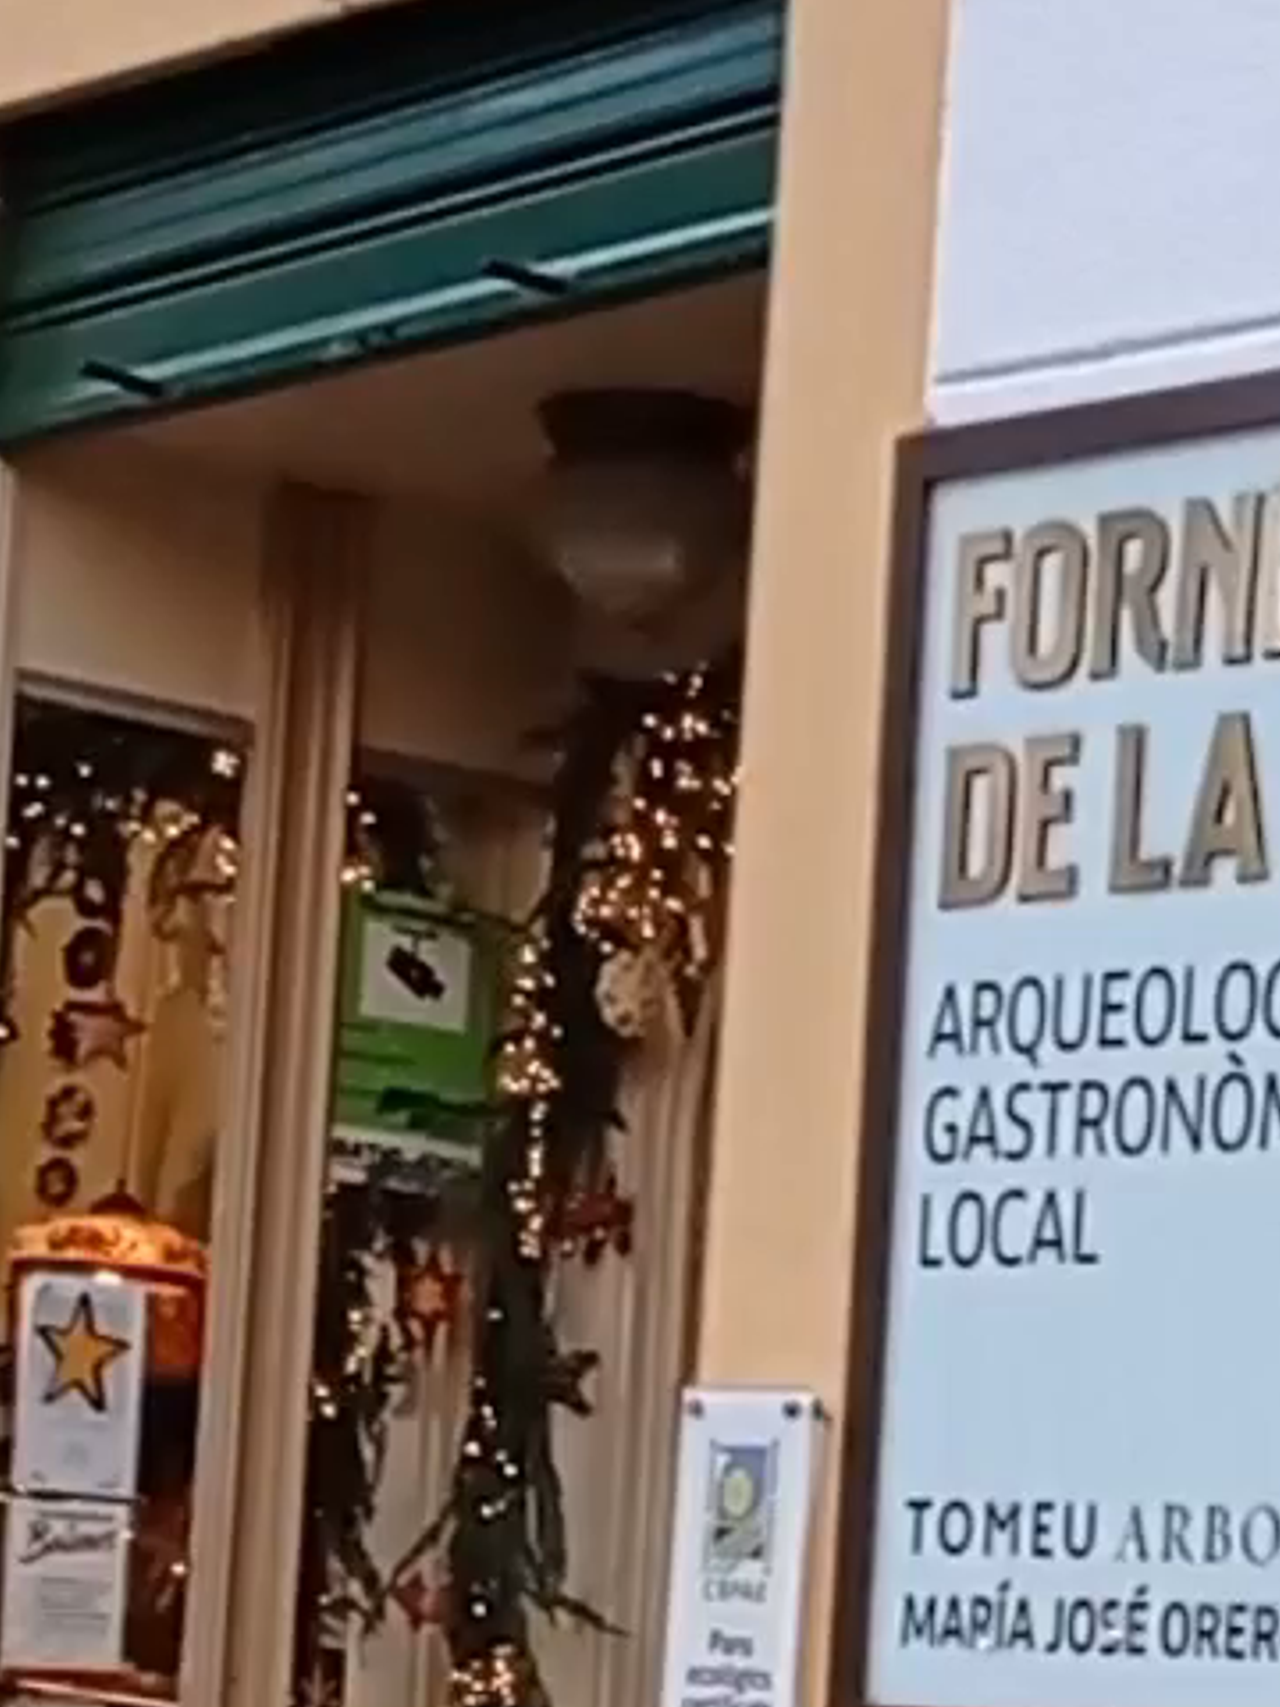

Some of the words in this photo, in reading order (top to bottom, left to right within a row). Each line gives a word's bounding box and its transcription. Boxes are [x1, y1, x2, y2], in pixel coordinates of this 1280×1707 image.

[937, 730, 1082, 911] DE
[1107, 711, 1272, 895] LA
[917, 1187, 1100, 1269] LOCAL
[906, 1498, 1098, 1559] TOMEU
[1047, 1586, 1148, 1657] JOSÉ
